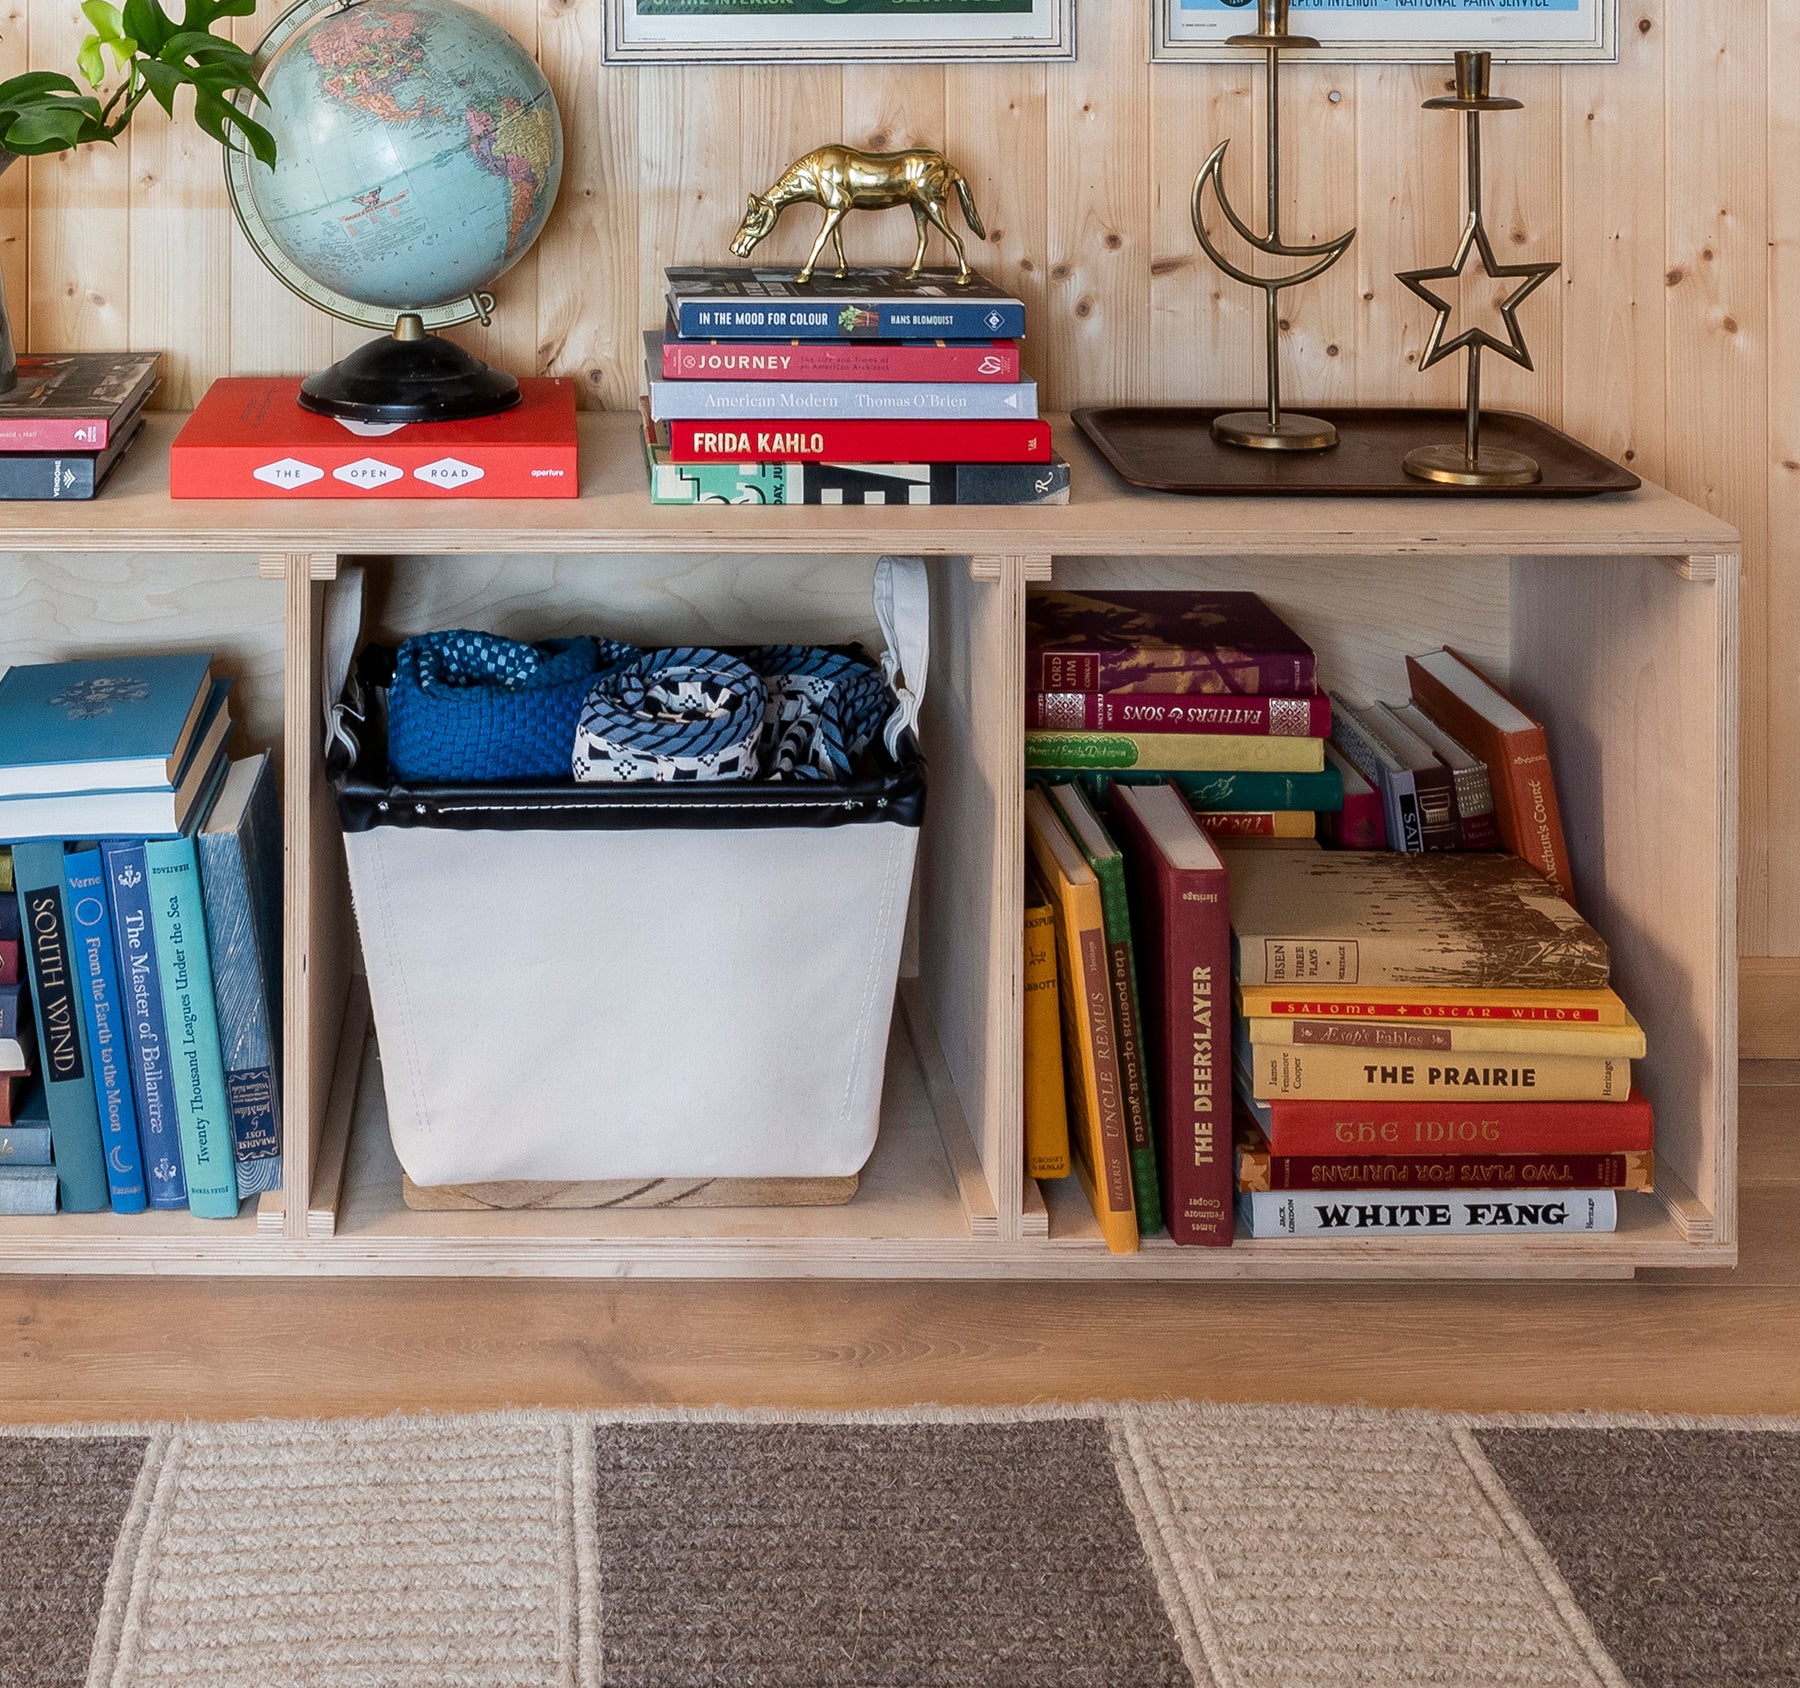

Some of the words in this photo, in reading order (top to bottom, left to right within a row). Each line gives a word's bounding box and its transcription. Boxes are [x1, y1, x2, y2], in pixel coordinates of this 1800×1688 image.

[699, 312, 710, 325] IN
[713, 312, 732, 325] THE
[736, 313, 764, 325] MOOD
[768, 313, 787, 326] FOR
[790, 313, 828, 326] COLOUR
[890, 315, 910, 325] HANS
[913, 315, 953, 326] BLOMQUIST
[698, 356, 791, 370] JOURNEY
[694, 433, 749, 453] FRIDA
[758, 433, 824, 454] KAHLO
[275, 469, 302, 478] THE
[350, 469, 388, 478] OPEN
[431, 469, 469, 478] ROAD
[1052, 656, 1061, 688] LORD
[1066, 660, 1076, 686] JIM
[168, 895, 180, 918] Sea
[32, 898, 65, 988] SOUTH
[170, 919, 184, 944] the
[175, 948, 188, 990] Under
[180, 993, 197, 1045] Leagues
[1423, 1006, 1492, 1017] OSCAR
[47, 995, 75, 1072] WIND
[1192, 965, 1213, 1112] DEERSLAYER
[184, 1050, 205, 1112] Thousand
[1364, 1066, 1415, 1085] THE
[1428, 1066, 1536, 1087] PRAIRIE
[197, 1117, 210, 1165] Twenty
[1195, 1122, 1214, 1166] THE
[1313, 1204, 1452, 1228] WHITE
[1465, 1202, 1570, 1226] FANG
